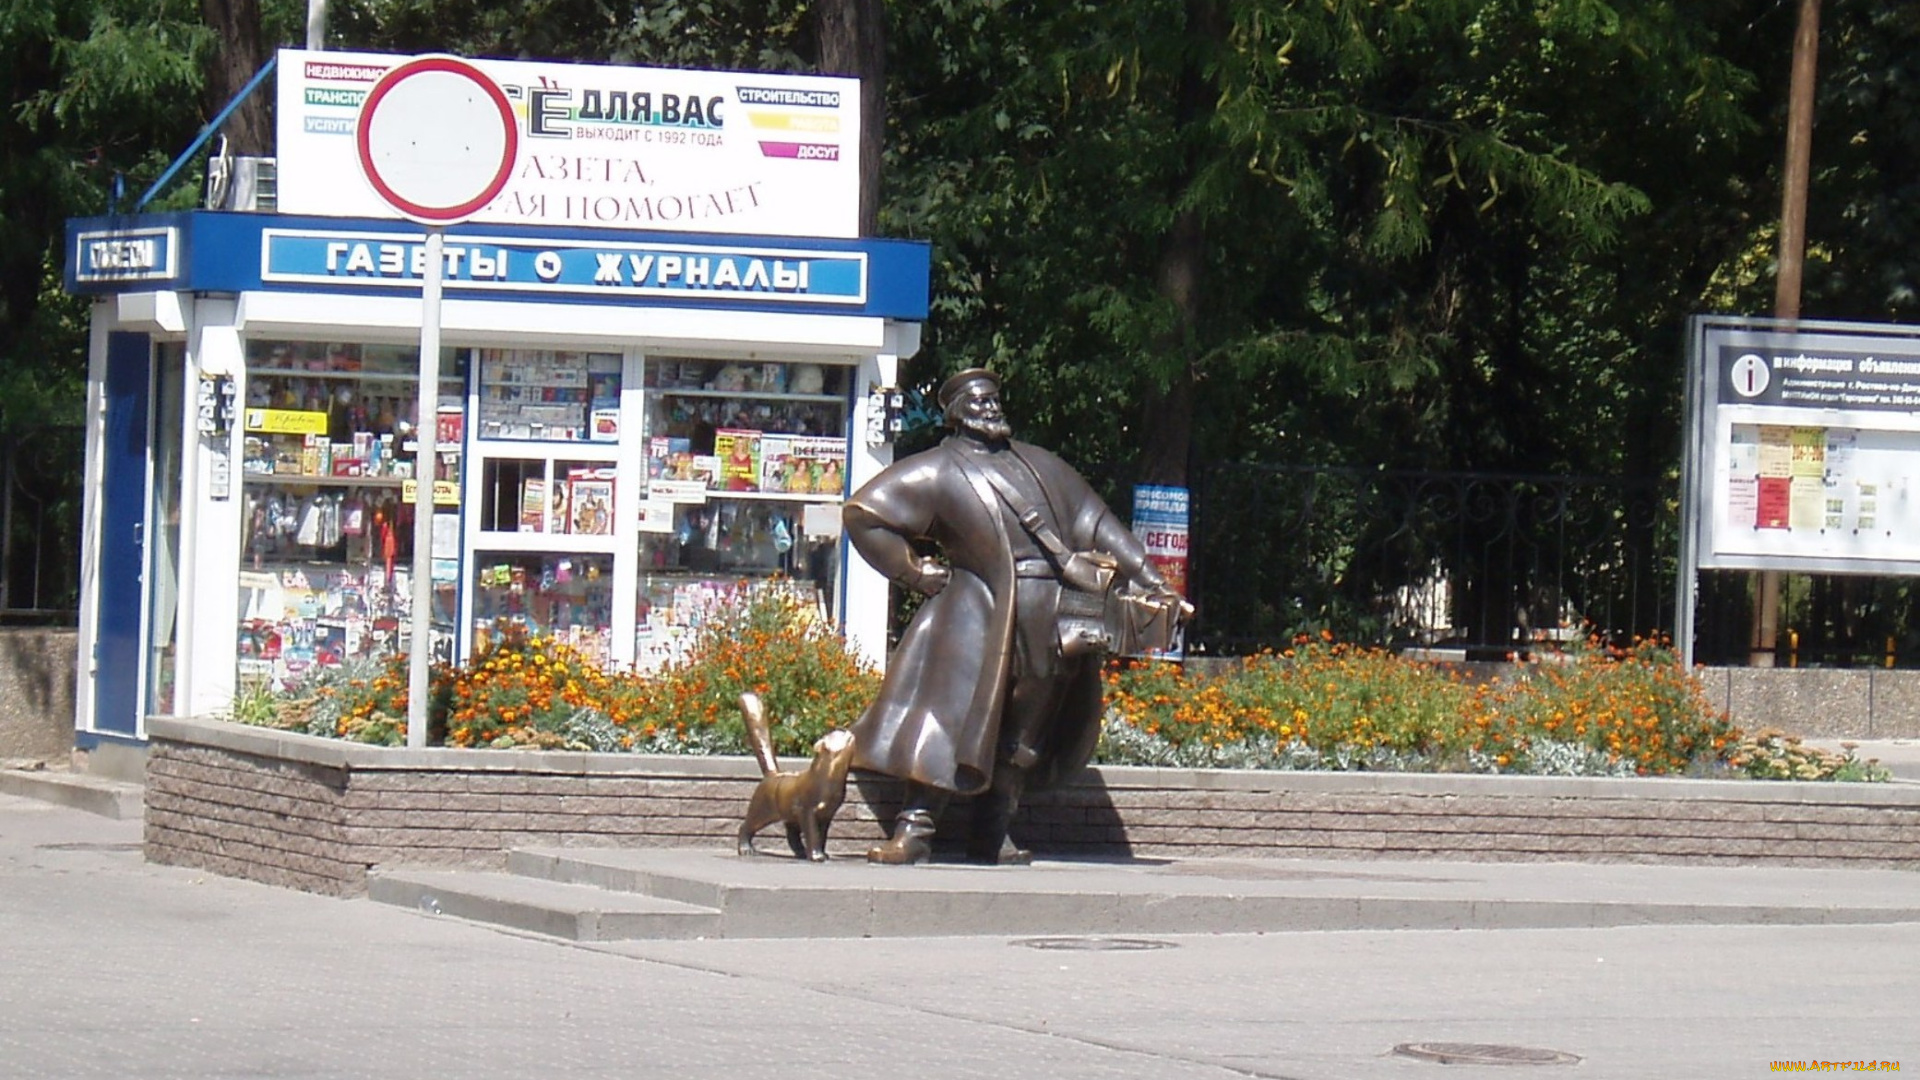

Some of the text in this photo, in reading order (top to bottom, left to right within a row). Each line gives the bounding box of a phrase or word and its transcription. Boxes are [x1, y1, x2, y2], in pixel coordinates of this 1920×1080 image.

[738, 88, 839, 106] СТРОИТЕЛЬСТВО
[579, 89, 651, 122] ДЛЯ
[661, 93, 724, 127] ВАС
[576, 126, 723, 147] ВЫХОДИТ С 1992 ГОДА
[797, 145, 838, 160] ДОСУГ
[326, 242, 508, 279] ГАЗЕТЫ
[594, 253, 809, 289] ЖУРНАЛЫ
